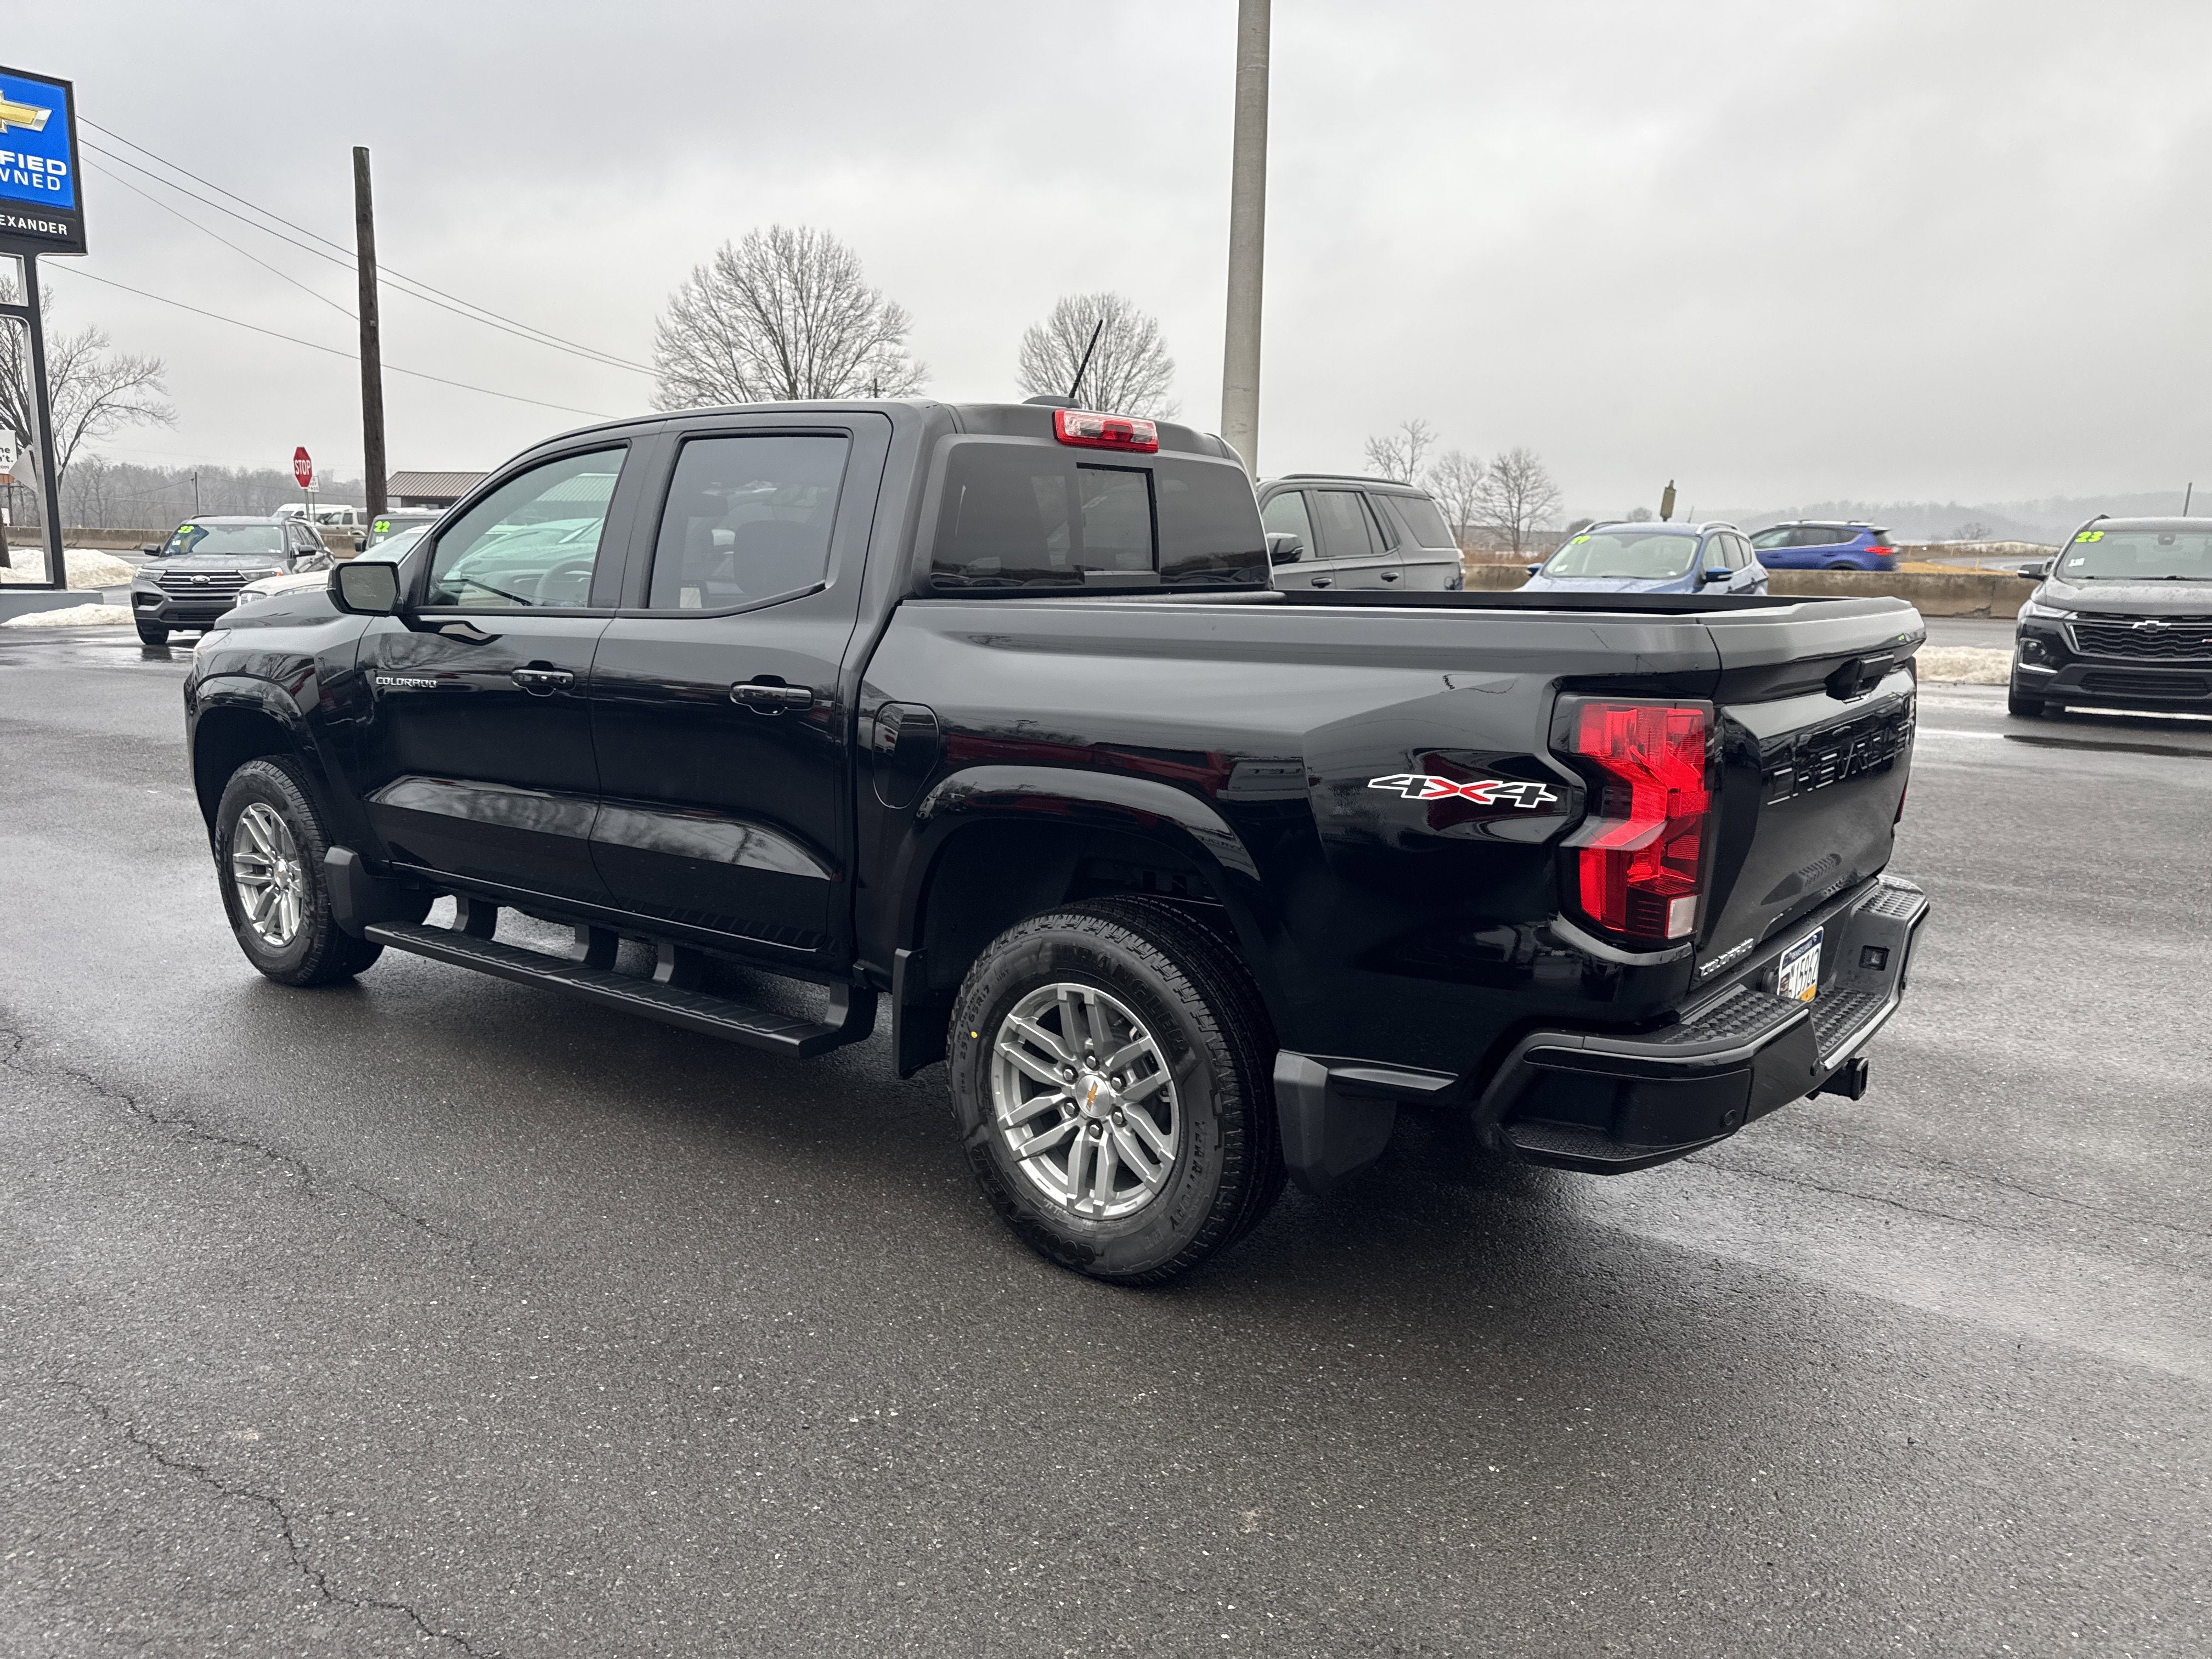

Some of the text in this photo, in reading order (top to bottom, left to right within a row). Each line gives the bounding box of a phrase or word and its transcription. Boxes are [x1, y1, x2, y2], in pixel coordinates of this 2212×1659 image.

[295, 459, 311, 476] STOP
[374, 521, 390, 533] 22
[2075, 531, 2104, 543] 23
[376, 676, 437, 689] COLORADO
